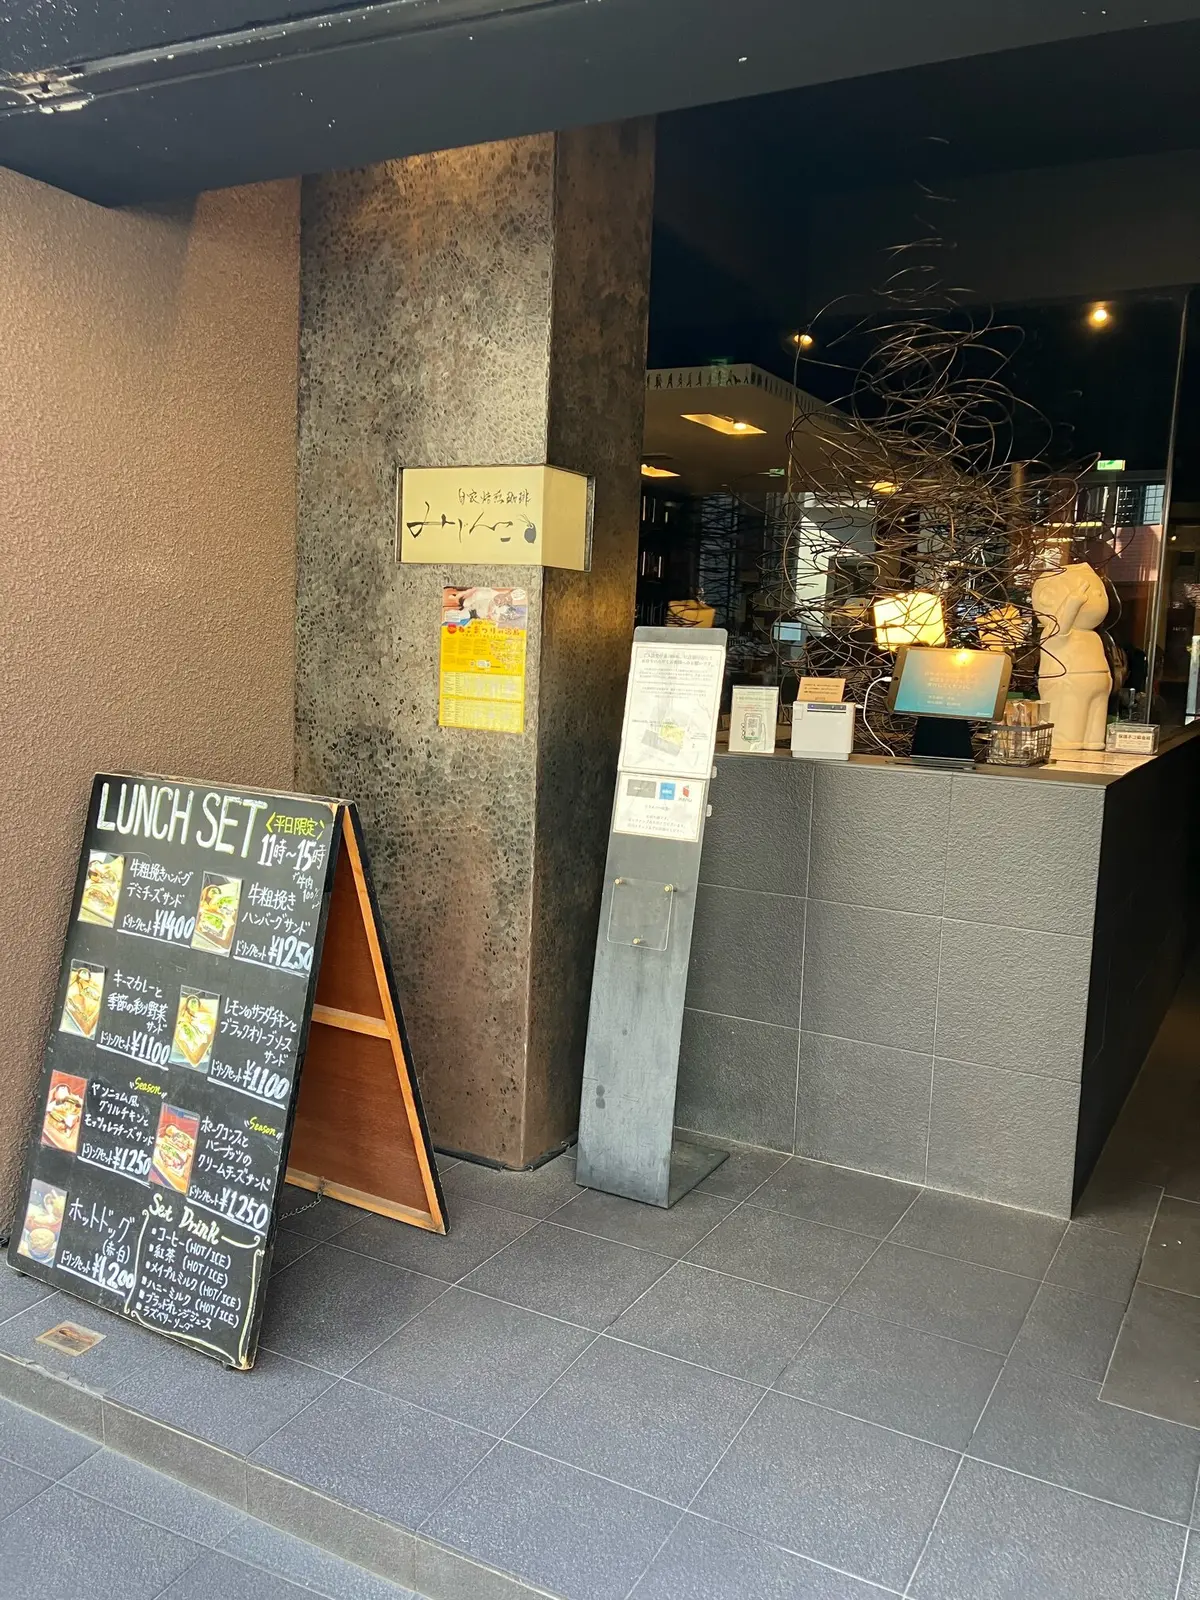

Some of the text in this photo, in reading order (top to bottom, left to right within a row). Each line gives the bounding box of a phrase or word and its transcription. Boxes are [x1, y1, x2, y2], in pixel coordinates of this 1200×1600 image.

[97, 782, 268, 858] LUNCH SET
[127, 882, 185, 908] デミチーズサンド
[247, 882, 297, 911] 牛粗挽き
[242, 911, 311, 936] ハンバーグサンド
[113, 969, 162, 998] キーマカレーと
[107, 992, 168, 1023] 季節の彩り野菜
[224, 997, 297, 1033] レモンのサラダチキンと
[146, 1020, 168, 1035] サンド
[220, 1018, 292, 1052] ブラックオリーブソース
[263, 1050, 289, 1067] サンド
[91, 1082, 140, 1107] ヤンニョム風
[99, 1100, 149, 1126] グリルチキンと
[200, 1115, 249, 1148] ポークコンフィと
[198, 1154, 272, 1191] クリームチーズサンド
[68, 1198, 135, 1243] ホットドッグ
[149, 1193, 220, 1245] Set Drink
[153, 1243, 176, 1264] 紅茶
